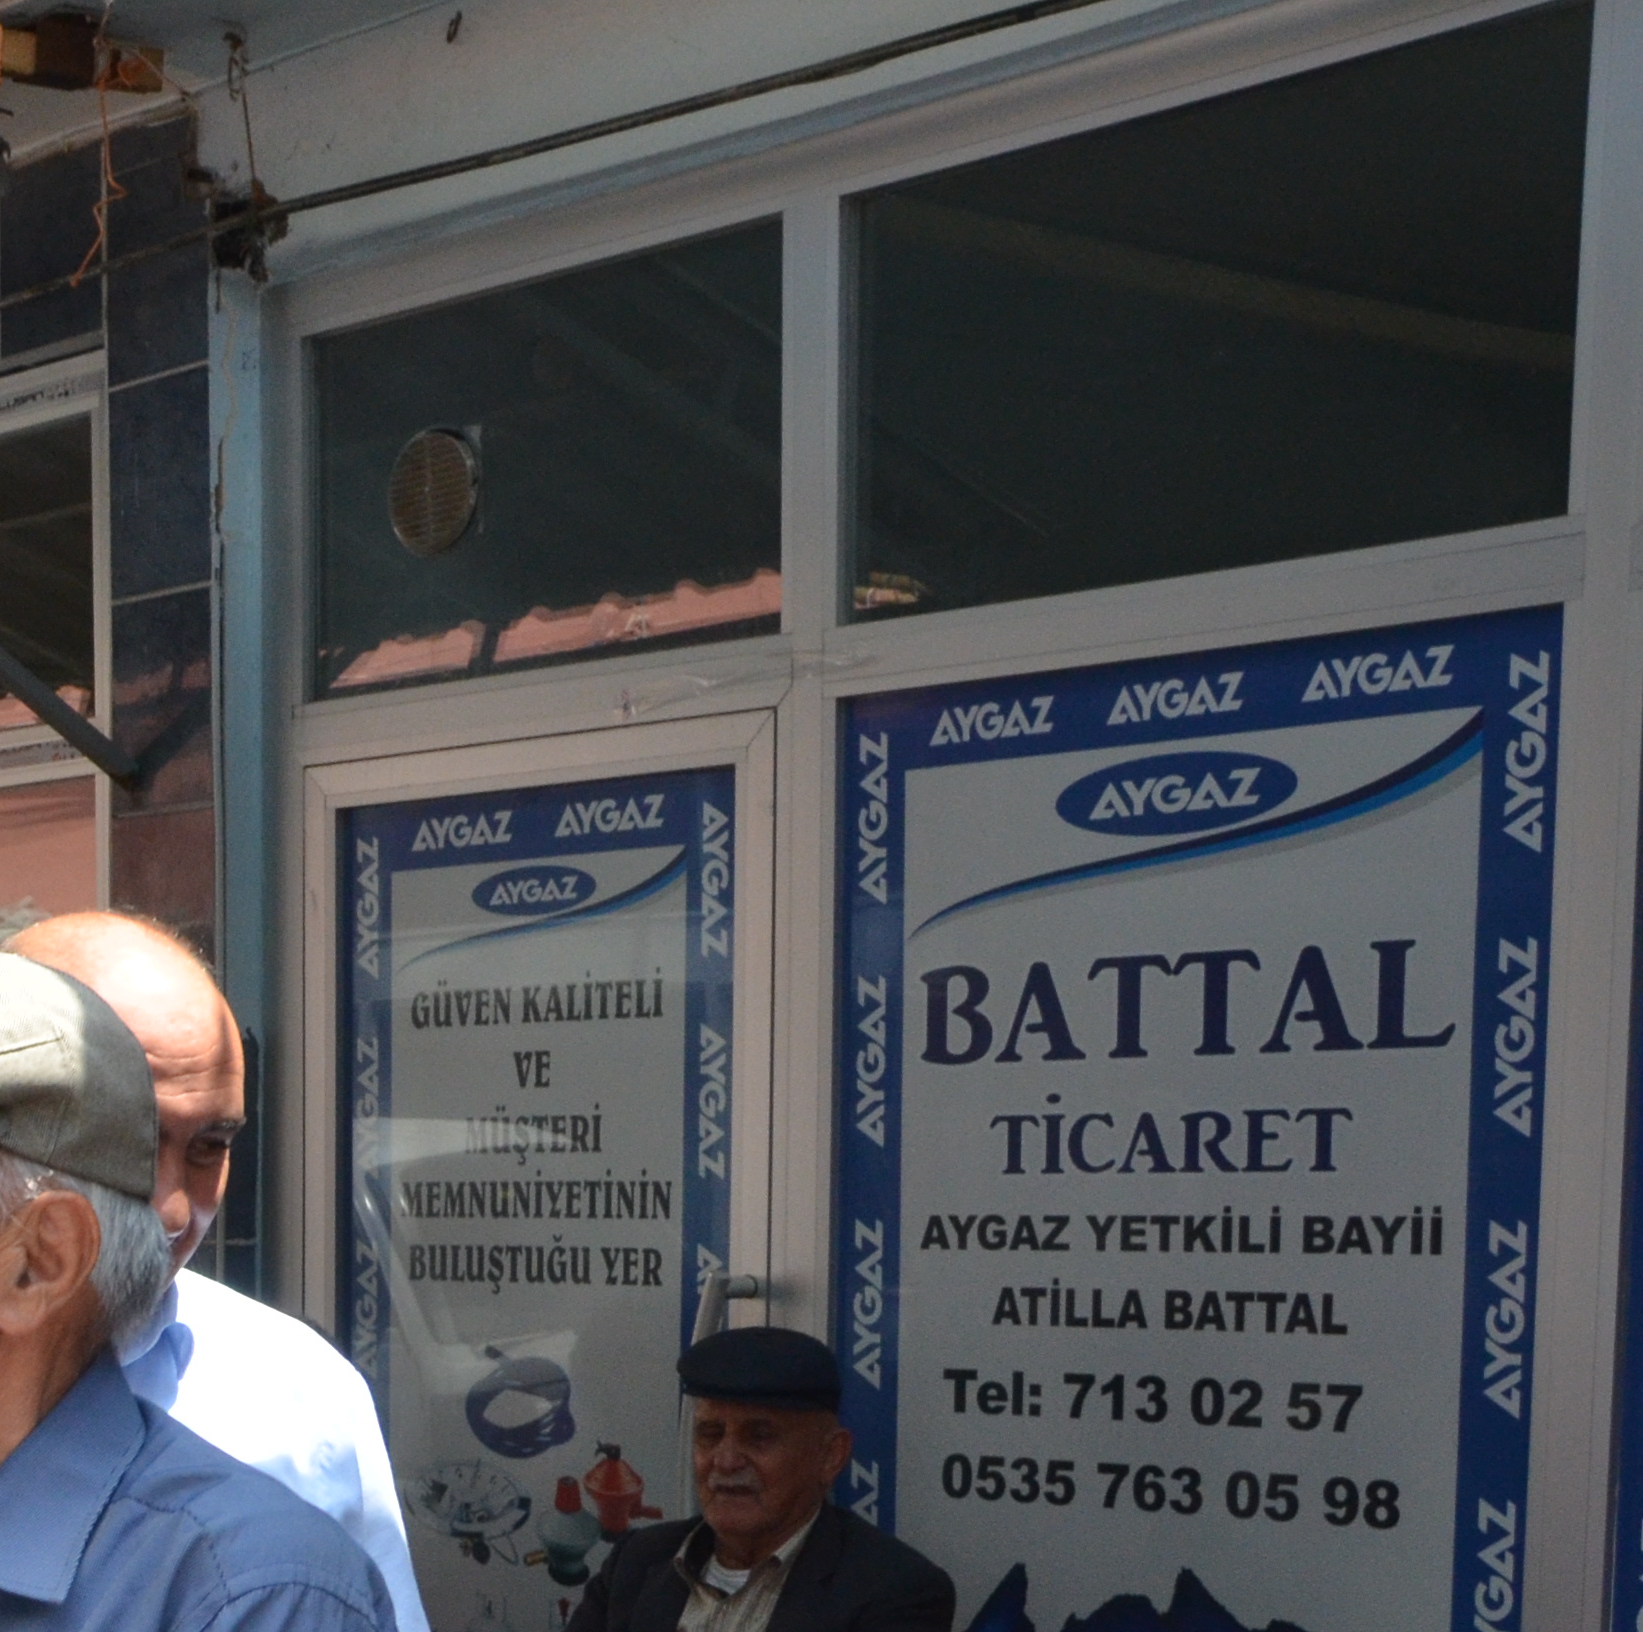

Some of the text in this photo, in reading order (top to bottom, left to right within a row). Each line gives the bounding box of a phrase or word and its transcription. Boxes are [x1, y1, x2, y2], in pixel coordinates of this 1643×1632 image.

[930, 645, 1454, 746] AYGAZ AYGAZ AYGAZ
[1504, 651, 1550, 852] AYGAZ
[412, 794, 664, 851] AYGAZ AYGAZ
[1090, 768, 1260, 820] AYGAZ
[354, 837, 379, 979] AYGAZ
[490, 876, 577, 905] AYGAZ
[411, 966, 663, 1030] GÜVEN KALİTELİ
[698, 801, 730, 1180] AYGAZ AYGAZ
[921, 940, 1455, 1065] BATTAL
[514, 1051, 550, 1088] VE
[853, 732, 888, 1388] AYGAZ AYGAZ AYGAZ
[1494, 938, 1538, 1137] AYGAZ
[466, 1103, 602, 1166] MÜŞTERİ
[990, 1094, 1352, 1174] TİCARET
[401, 1169, 672, 1219] MEMNUNİYETİNİN
[921, 1215, 1069, 1251] AYGAZ
[1086, 1206, 1281, 1253] YETKİLİ
[409, 1235, 591, 1294] BULUŞTUĞU
[601, 1247, 662, 1286] YER
[354, 1239, 379, 1380] AYGAZ
[993, 1278, 1347, 1335] ATİLLA BATTAL
[1484, 1221, 1527, 1418] AYGAZ
[944, 1369, 1363, 1432] Tel: 713 02 57
[942, 1454, 1400, 1529] 0535 763 05 98
